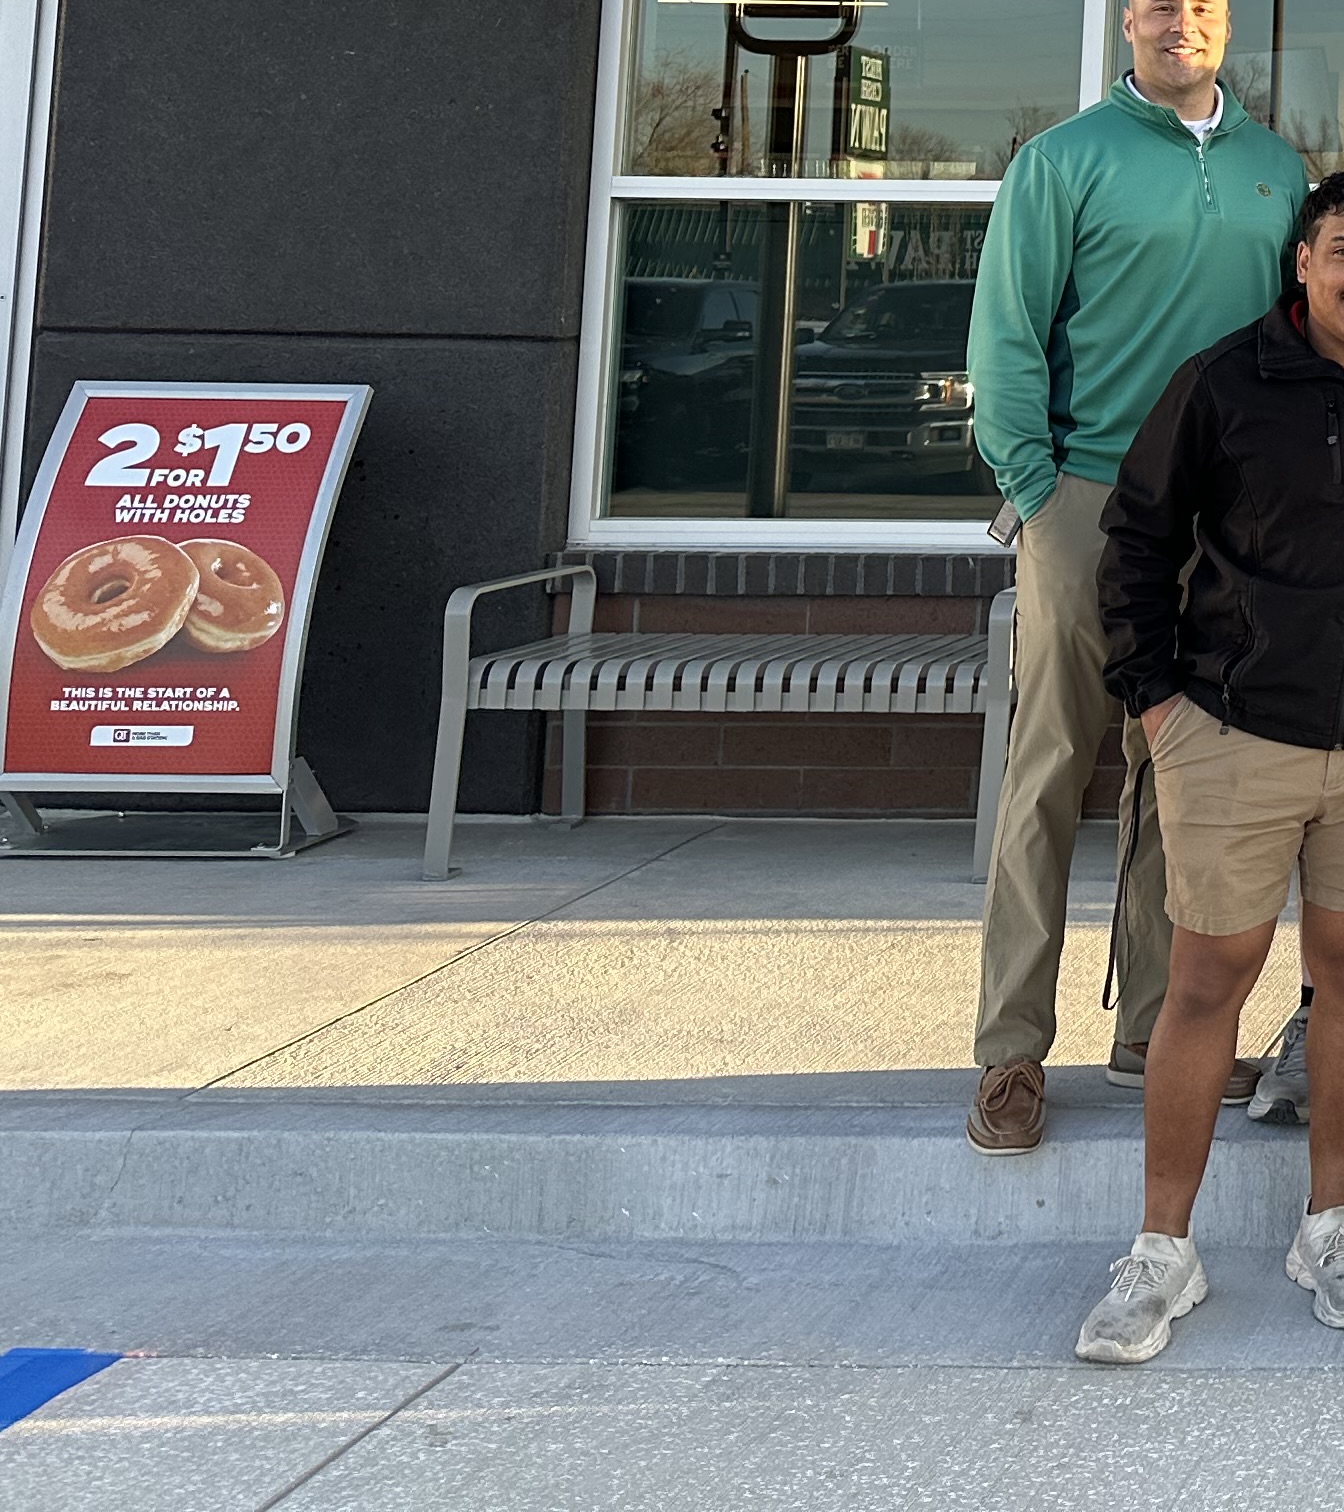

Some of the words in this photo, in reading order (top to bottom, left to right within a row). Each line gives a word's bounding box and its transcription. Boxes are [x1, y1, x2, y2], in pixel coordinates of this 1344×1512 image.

[85, 423, 160, 486] 2
[150, 469, 205, 487] FOR
[116, 494, 157, 509] ALL
[163, 494, 251, 509] DONUTS
[115, 509, 168, 523] WITH
[173, 509, 245, 523] HOLES
[63, 688, 96, 698] THIS
[99, 688, 112, 698] IS
[116, 688, 145, 698] THE
[147, 688, 193, 698] START
[196, 688, 216, 698] OF
[219, 688, 230, 698] A
[50, 701, 129, 711] BEAUTIFUL
[132, 701, 240, 711] RELATIONSHIP.
[115, 730, 129, 741] QT
